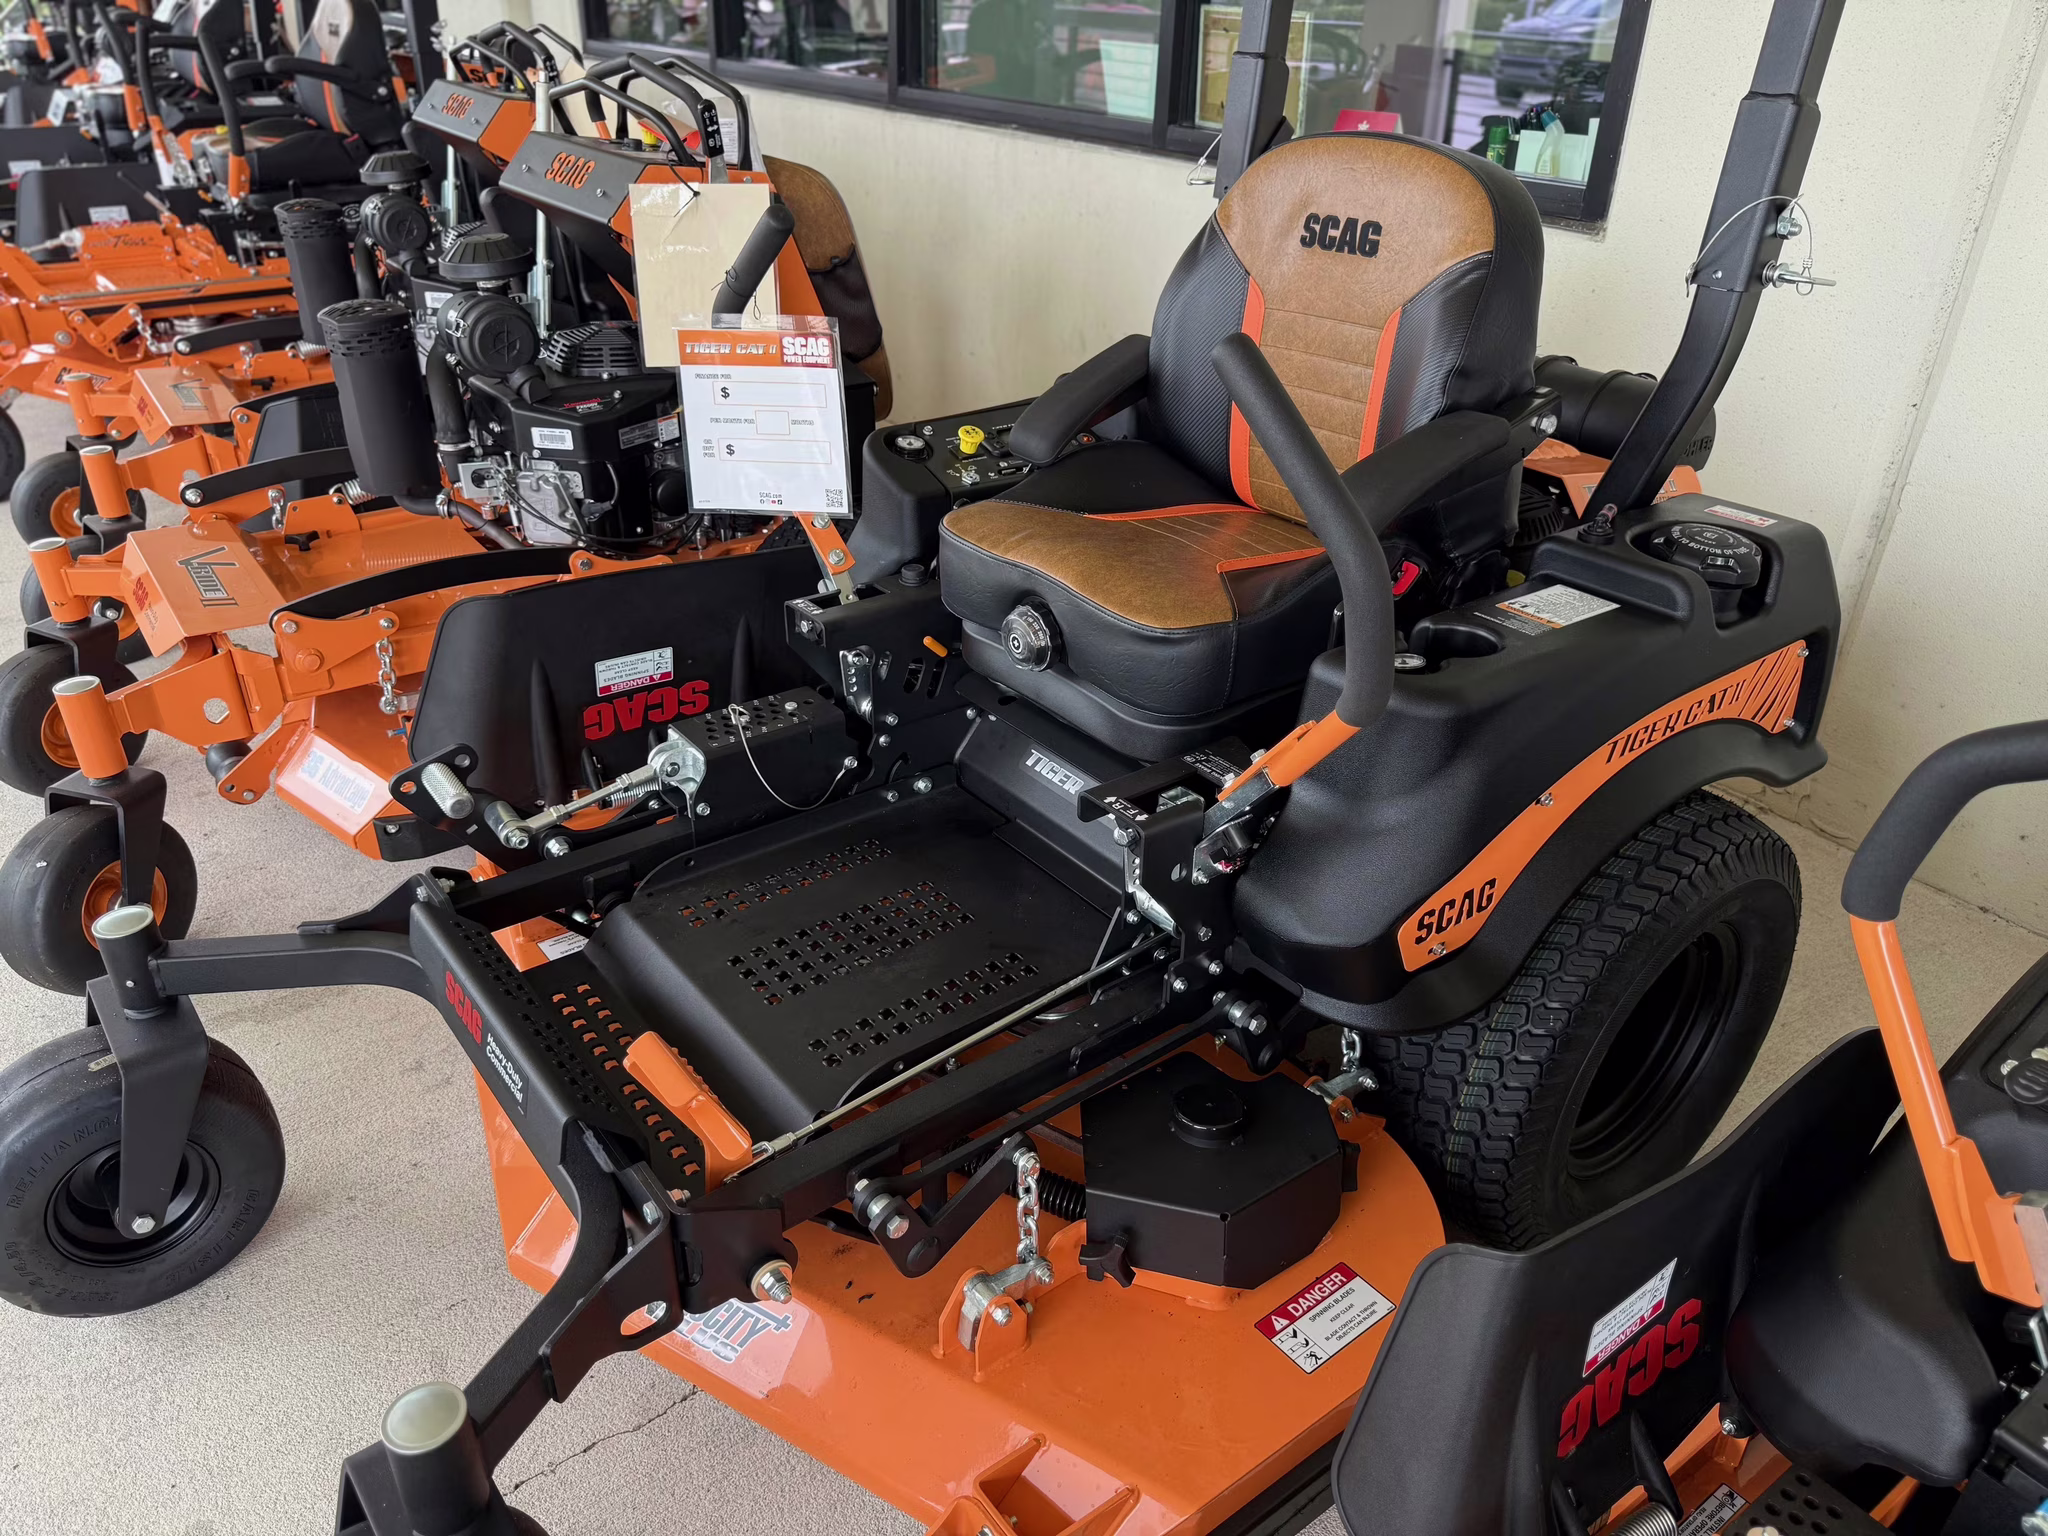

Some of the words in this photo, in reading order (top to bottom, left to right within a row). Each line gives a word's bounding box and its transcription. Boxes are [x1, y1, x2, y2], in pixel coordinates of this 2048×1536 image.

[441, 92, 475, 119] SCAG
[546, 152, 596, 190] SCAG
[1300, 212, 1383, 258] SCAG
[683, 342, 732, 354] TIGER
[735, 343, 767, 355] CAT
[769, 345, 778, 354] II
[782, 336, 830, 357] SCAG
[720, 386, 730, 400] $
[725, 443, 736, 457] $
[759, 491, 783, 499] SCAG.com
[1687, 541, 1722, 554] BOTTOM
[610, 674, 650, 692] DANGER
[583, 679, 710, 740] SCAG
[1606, 710, 1683, 765] TIGER
[1683, 684, 1734, 727] CAT
[318, 761, 371, 809] Advantage
[1025, 749, 1085, 795] TIGER
[1415, 878, 1497, 945] SCAG
[445, 970, 483, 1045] SCAG
[486, 1045, 524, 1103] Commercial
[487, 1033, 523, 1090] Heavy-Duty
[1287, 1272, 1348, 1317] DANGER
[1308, 1301, 1336, 1322] SPINNING
[1333, 1287, 1355, 1305] BLADES
[1330, 1311, 1342, 1323] KEEP
[1340, 1303, 1355, 1315] CLEAR
[1324, 1329, 1340, 1342] BLADE
[1338, 1315, 1358, 1332] CONTACT
[1359, 1300, 1378, 1315] THROWN
[1335, 1326, 1355, 1341] OBJECTS
[1354, 1318, 1364, 1328] CAN
[1362, 1309, 1378, 1322] INJURE
[1597, 1319, 1640, 1361] DANGER
[1556, 1298, 1702, 1458] SCAG
[1703, 1516, 1726, 1536] INSTALL
[1705, 1502, 1726, 1522] BEFORE
